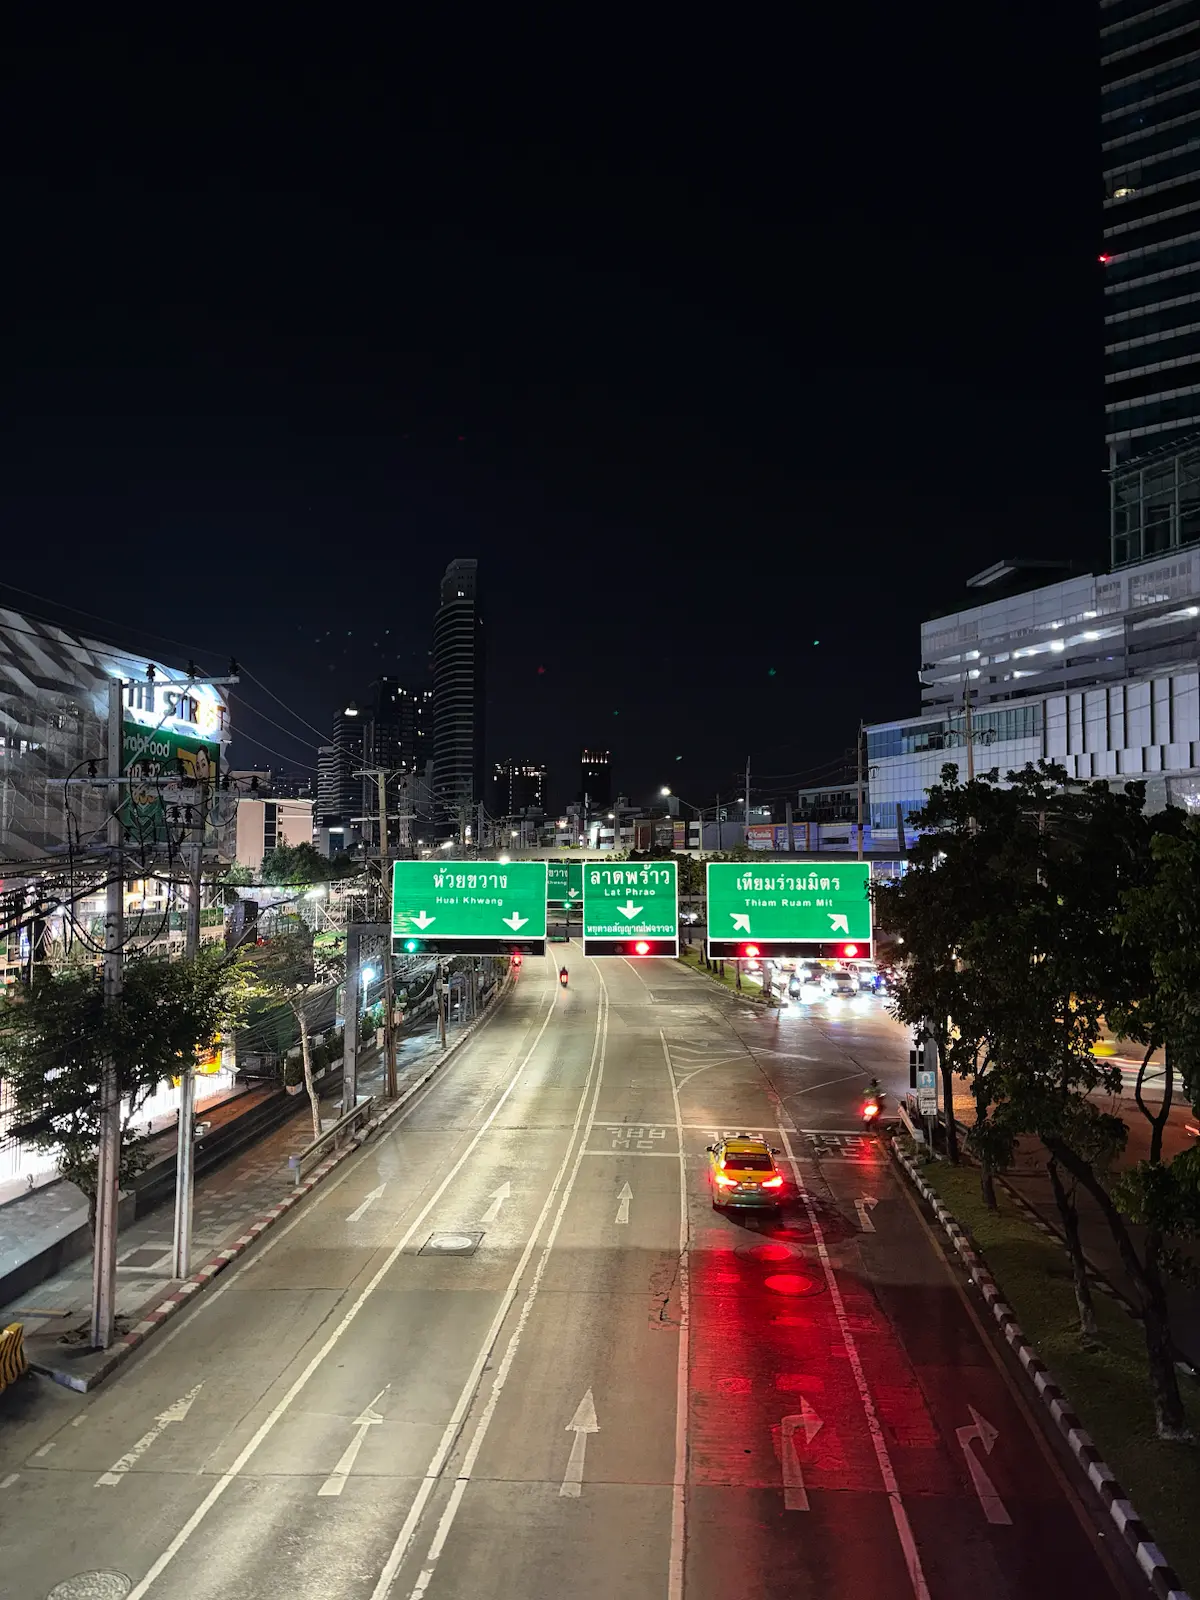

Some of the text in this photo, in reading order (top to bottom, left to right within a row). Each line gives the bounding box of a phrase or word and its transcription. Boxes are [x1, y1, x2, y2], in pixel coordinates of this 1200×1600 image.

[434, 867, 508, 889] ห้วยขวาง
[590, 864, 671, 885] ลาดพร้าว
[736, 871, 840, 891] เทียมร่วมมิตร
[604, 888, 656, 896] Lat Phrao
[436, 896, 503, 906] Huai Khwang
[745, 898, 833, 907] Thiam Ruam Mit
[612, 1139, 654, 1149] MC
[814, 1147, 860, 1157] MC
